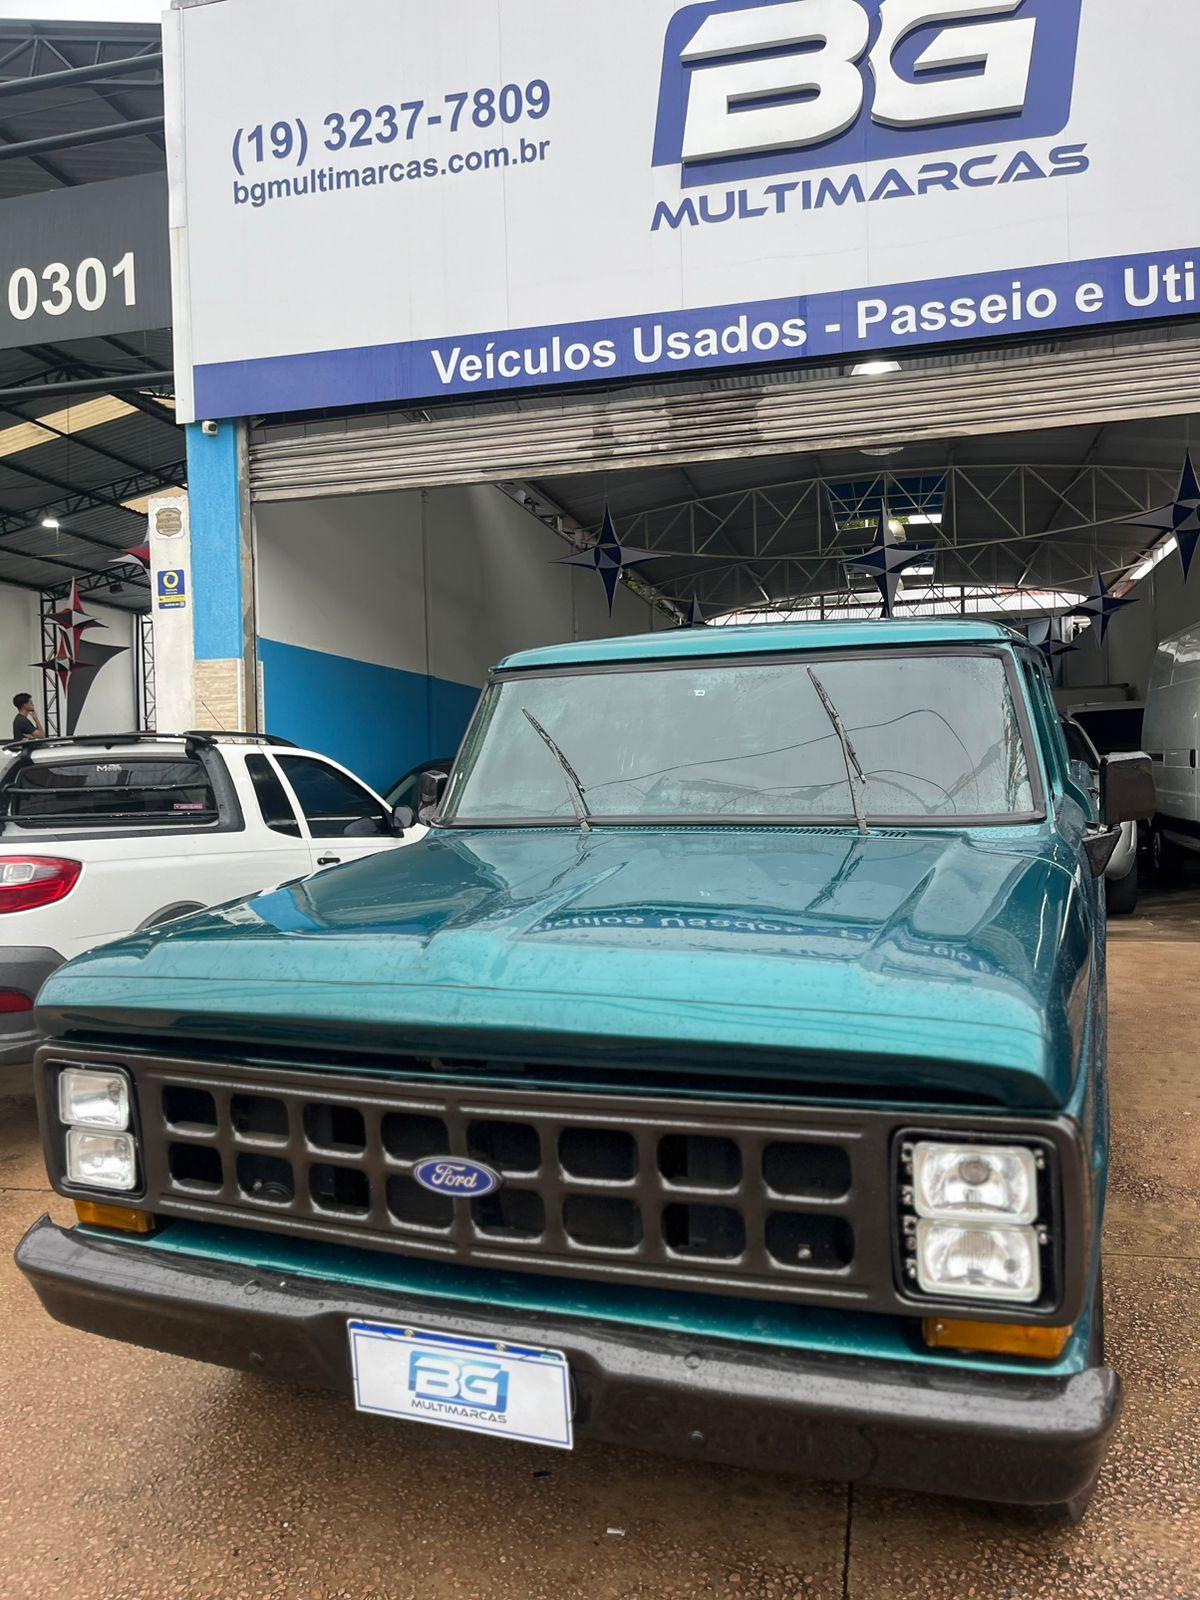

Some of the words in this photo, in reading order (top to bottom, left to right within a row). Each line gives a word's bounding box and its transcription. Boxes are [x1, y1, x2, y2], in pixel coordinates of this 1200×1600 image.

[680, 0, 1036, 164] BG
[231, 118, 308, 174] (19)
[323, 79, 551, 151] 3237-7809
[233, 136, 550, 207] bgmultimarcas.com.br
[650, 143, 1089, 231] MULTIMARCAS
[8, 252, 136, 320] 0301
[430, 331, 617, 385] Veículos
[633, 315, 807, 363] Usados
[825, 323, 840, 334] -
[857, 281, 1057, 338] Passeio
[1075, 281, 1104, 313] e
[431, 1164, 477, 1188] Ford
[411, 1399, 507, 1424] MULTIMARCAS
[413, 1357, 500, 1406] BG
